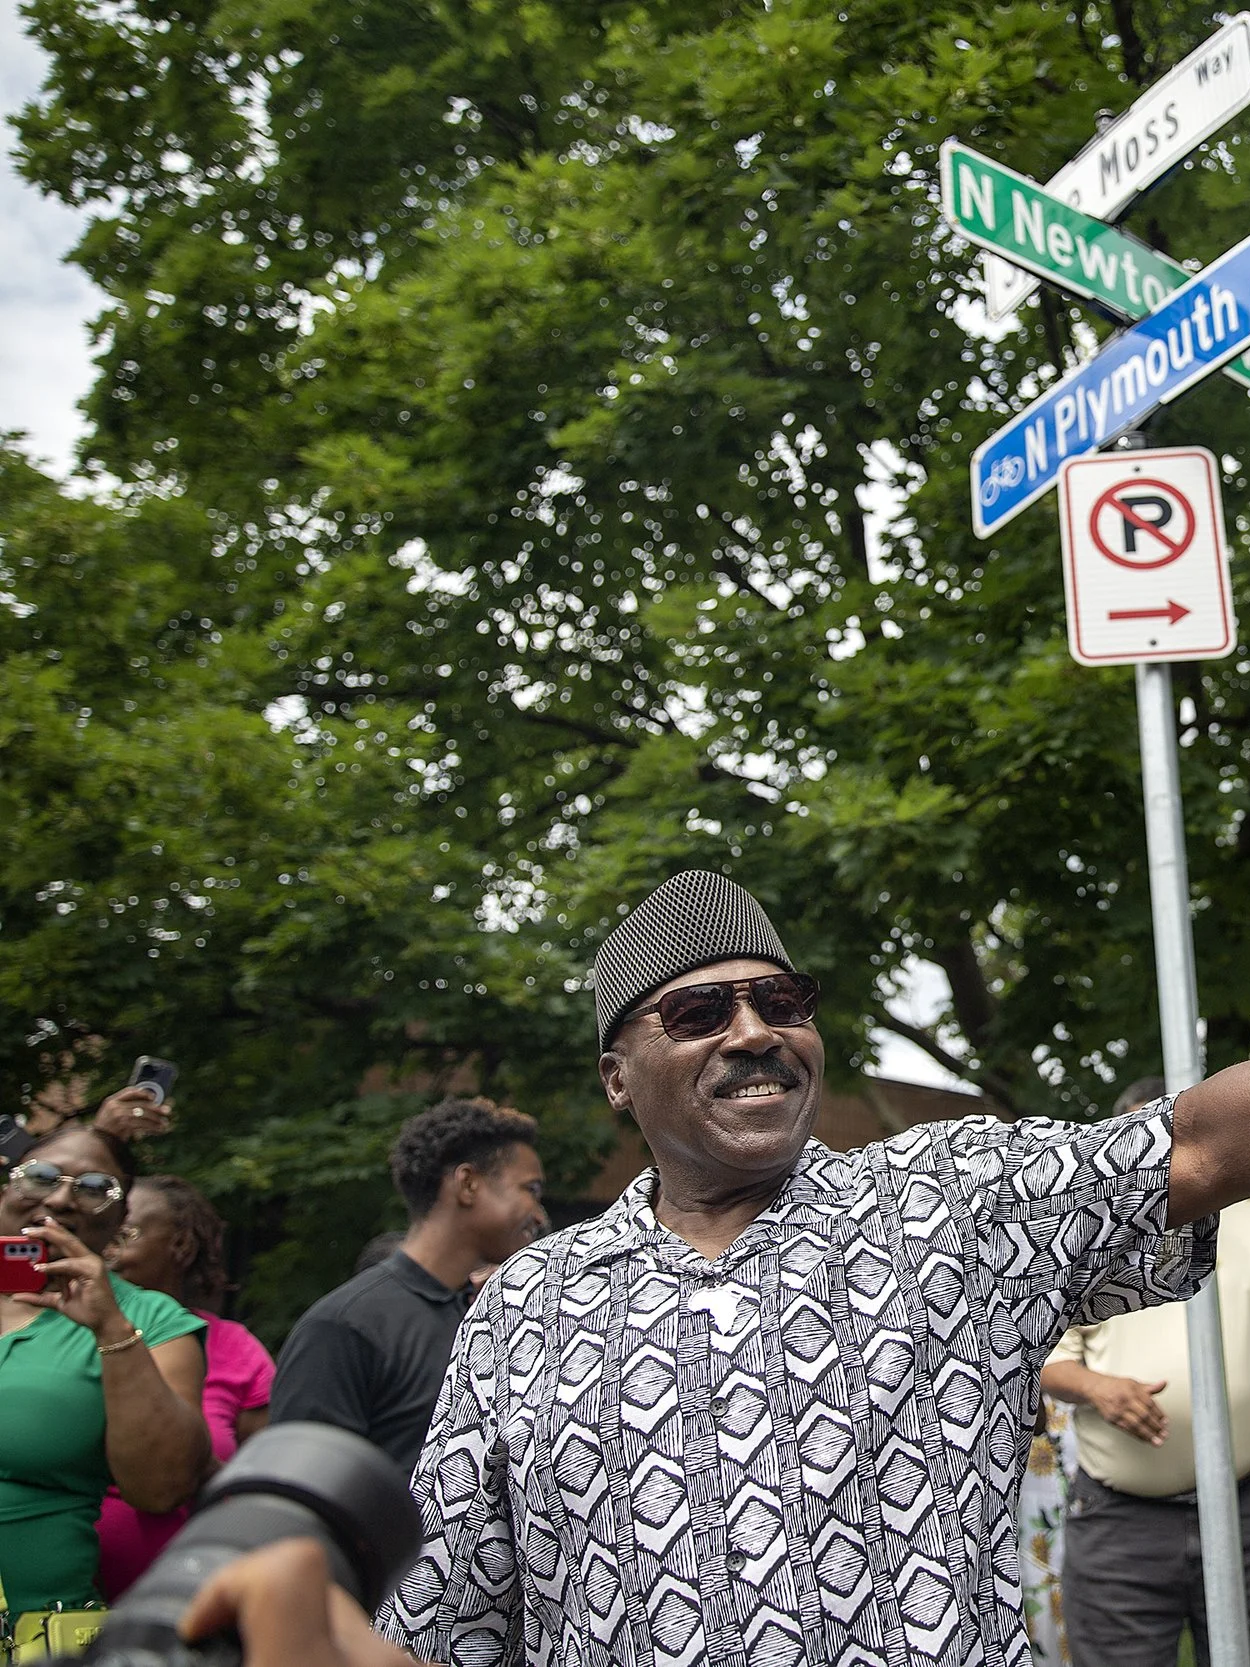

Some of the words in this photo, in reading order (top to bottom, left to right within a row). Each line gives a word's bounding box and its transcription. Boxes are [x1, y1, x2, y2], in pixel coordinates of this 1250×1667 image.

[1100, 101, 1179, 196] Moss
[1194, 44, 1233, 87] Way
[958, 163, 996, 231] N
[1011, 188, 1176, 311] Newto
[1025, 419, 1048, 482] N
[1054, 282, 1240, 458] Plymouth
